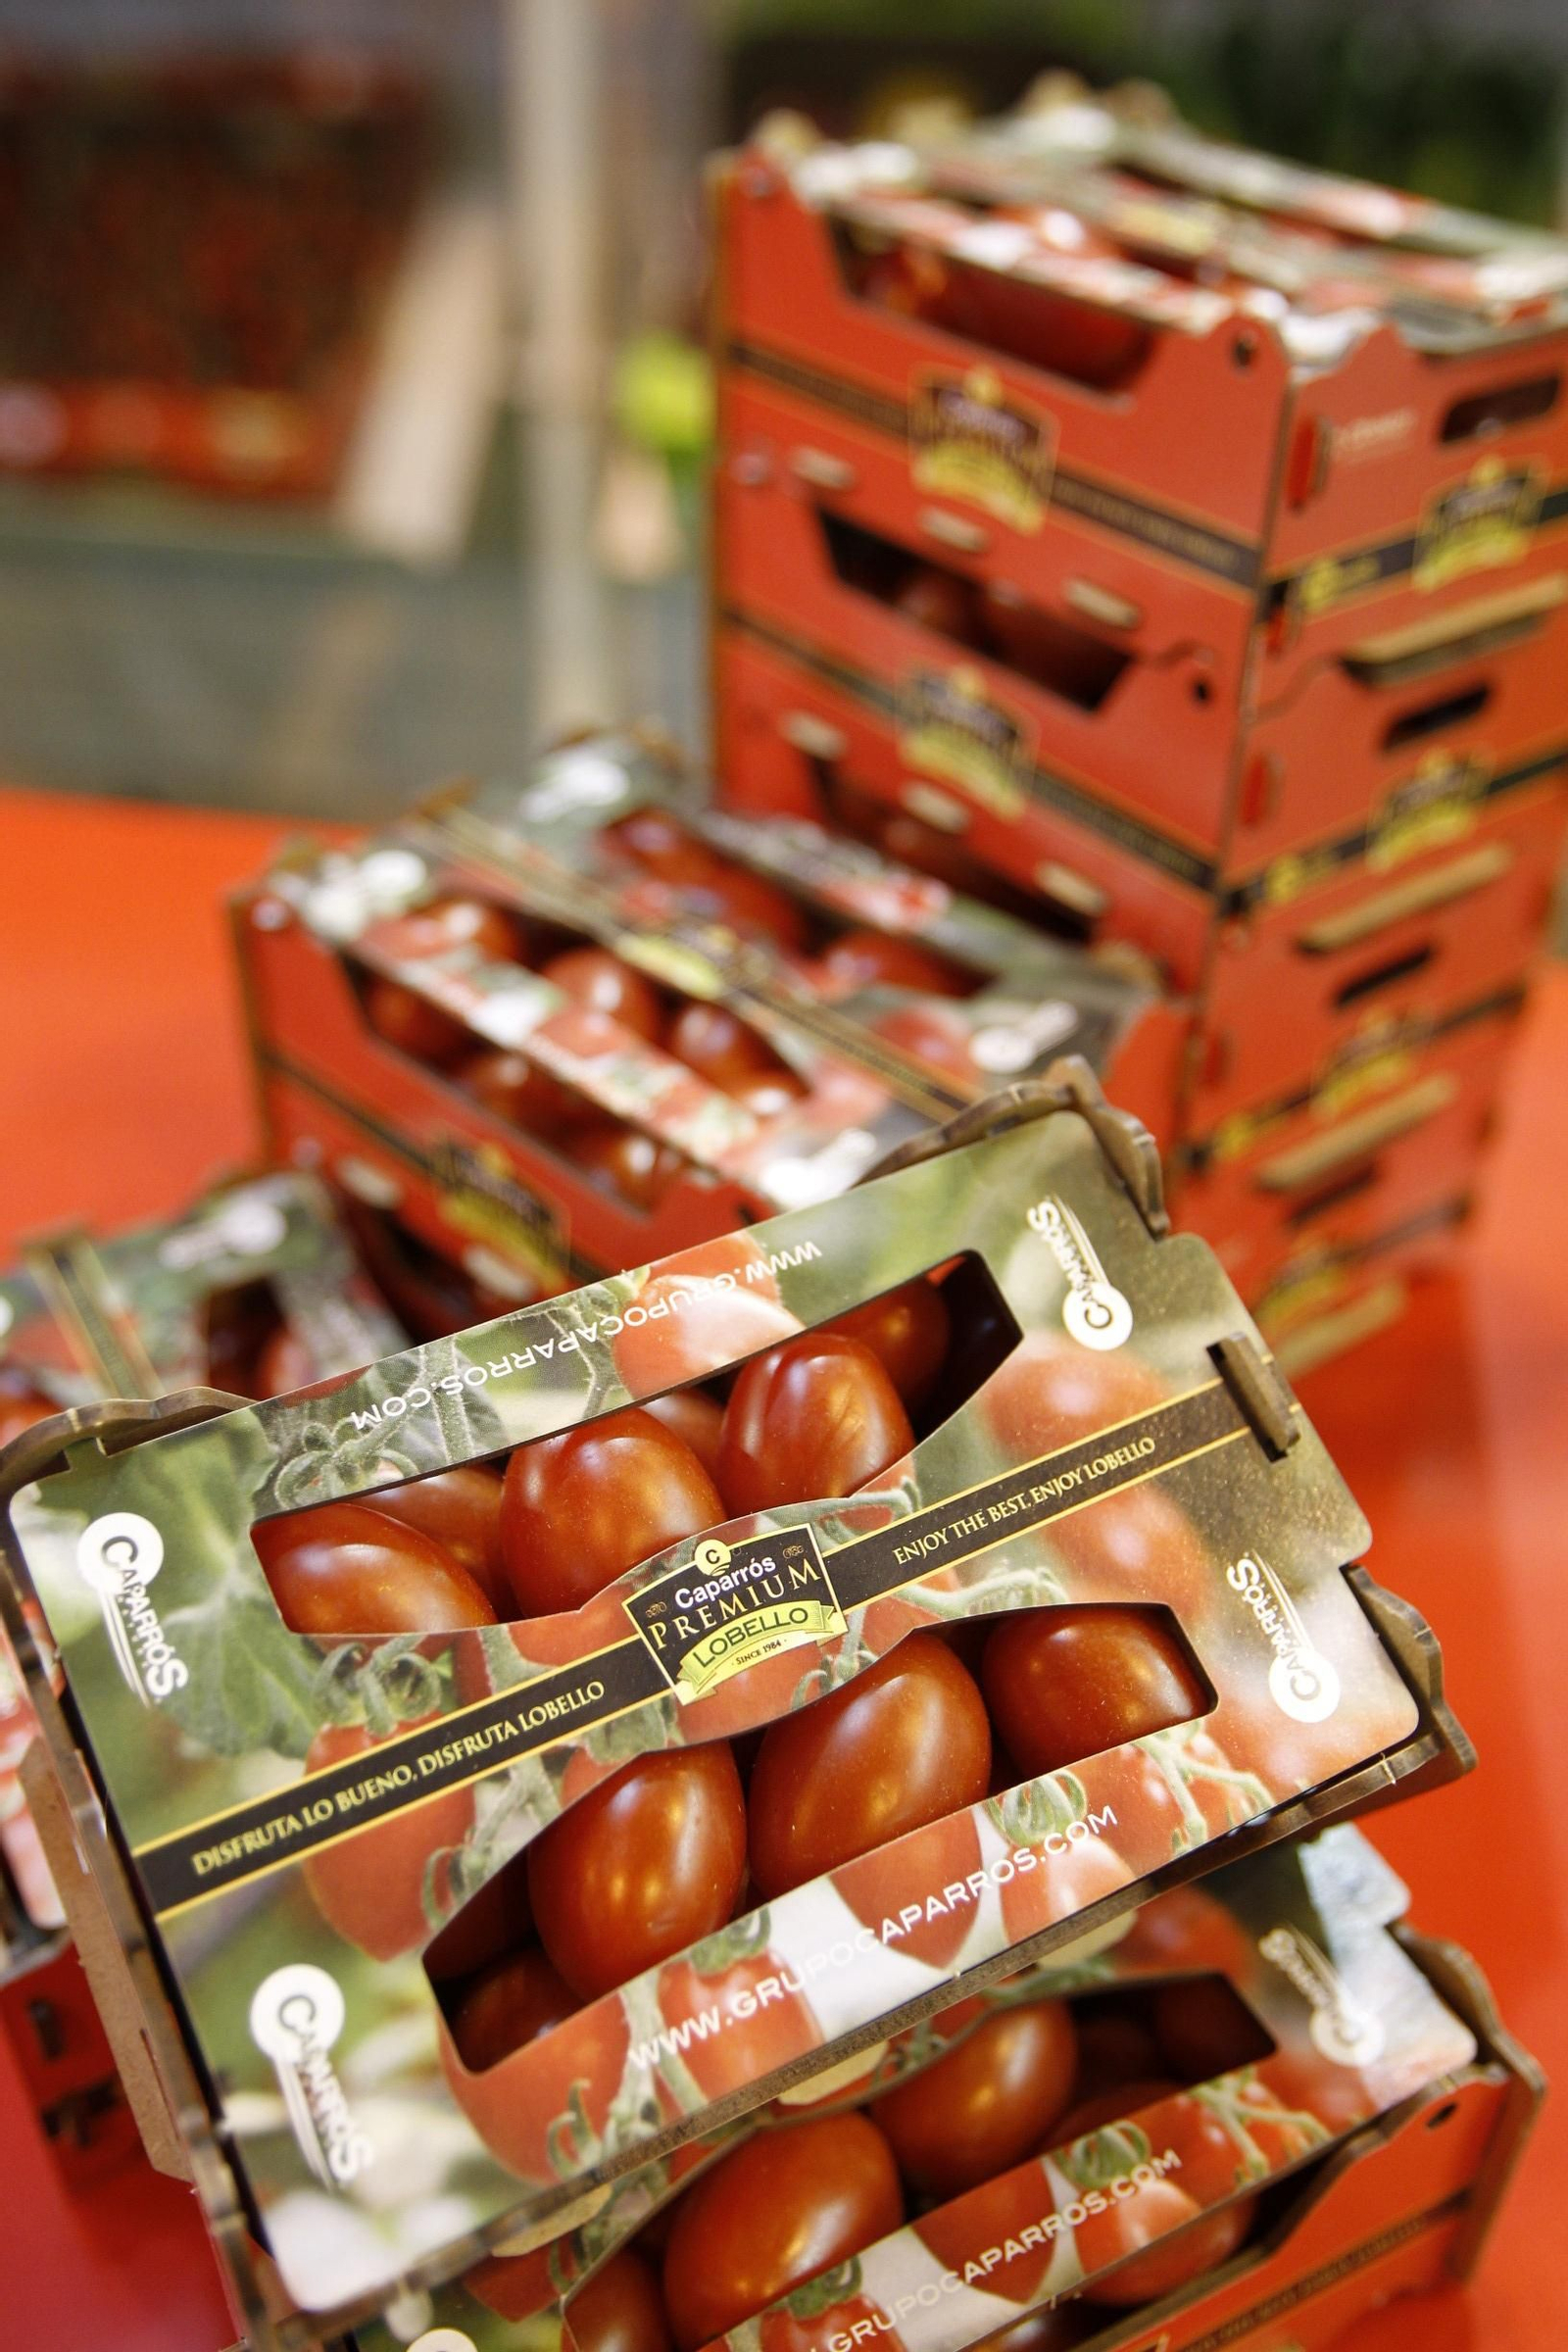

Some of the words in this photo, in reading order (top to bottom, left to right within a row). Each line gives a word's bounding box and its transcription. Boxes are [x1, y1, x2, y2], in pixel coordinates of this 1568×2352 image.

[350, 1241, 822, 1430] WWW.GRUPOCAPARROS.COM
[893, 1527, 951, 1565] ENJOY
[950, 1509, 989, 1540] THE
[1029, 1468, 1083, 1504] ENJOY
[1083, 1437, 1156, 1480] LOBELLO
[101, 1536, 189, 1696] CAPARRÓS
[647, 1557, 821, 1650] PREMIUM
[674, 1553, 776, 1609] Caparrós
[693, 1607, 808, 1668] LOBELLO
[735, 1648, 761, 1665] SINCE
[762, 1639, 782, 1653] 1984
[192, 1815, 303, 1876] DISFRUTA
[301, 1797, 335, 1829] LO
[334, 1764, 418, 1813] BUENO,
[416, 1721, 519, 1778] DISFRUTA
[517, 1681, 606, 1732] LOBELLO
[626, 1804, 1118, 2071] WWW.GRUPOCAPARROS.COM
[810, 2149, 1183, 2352] GRUPOCAPARROS.COM
